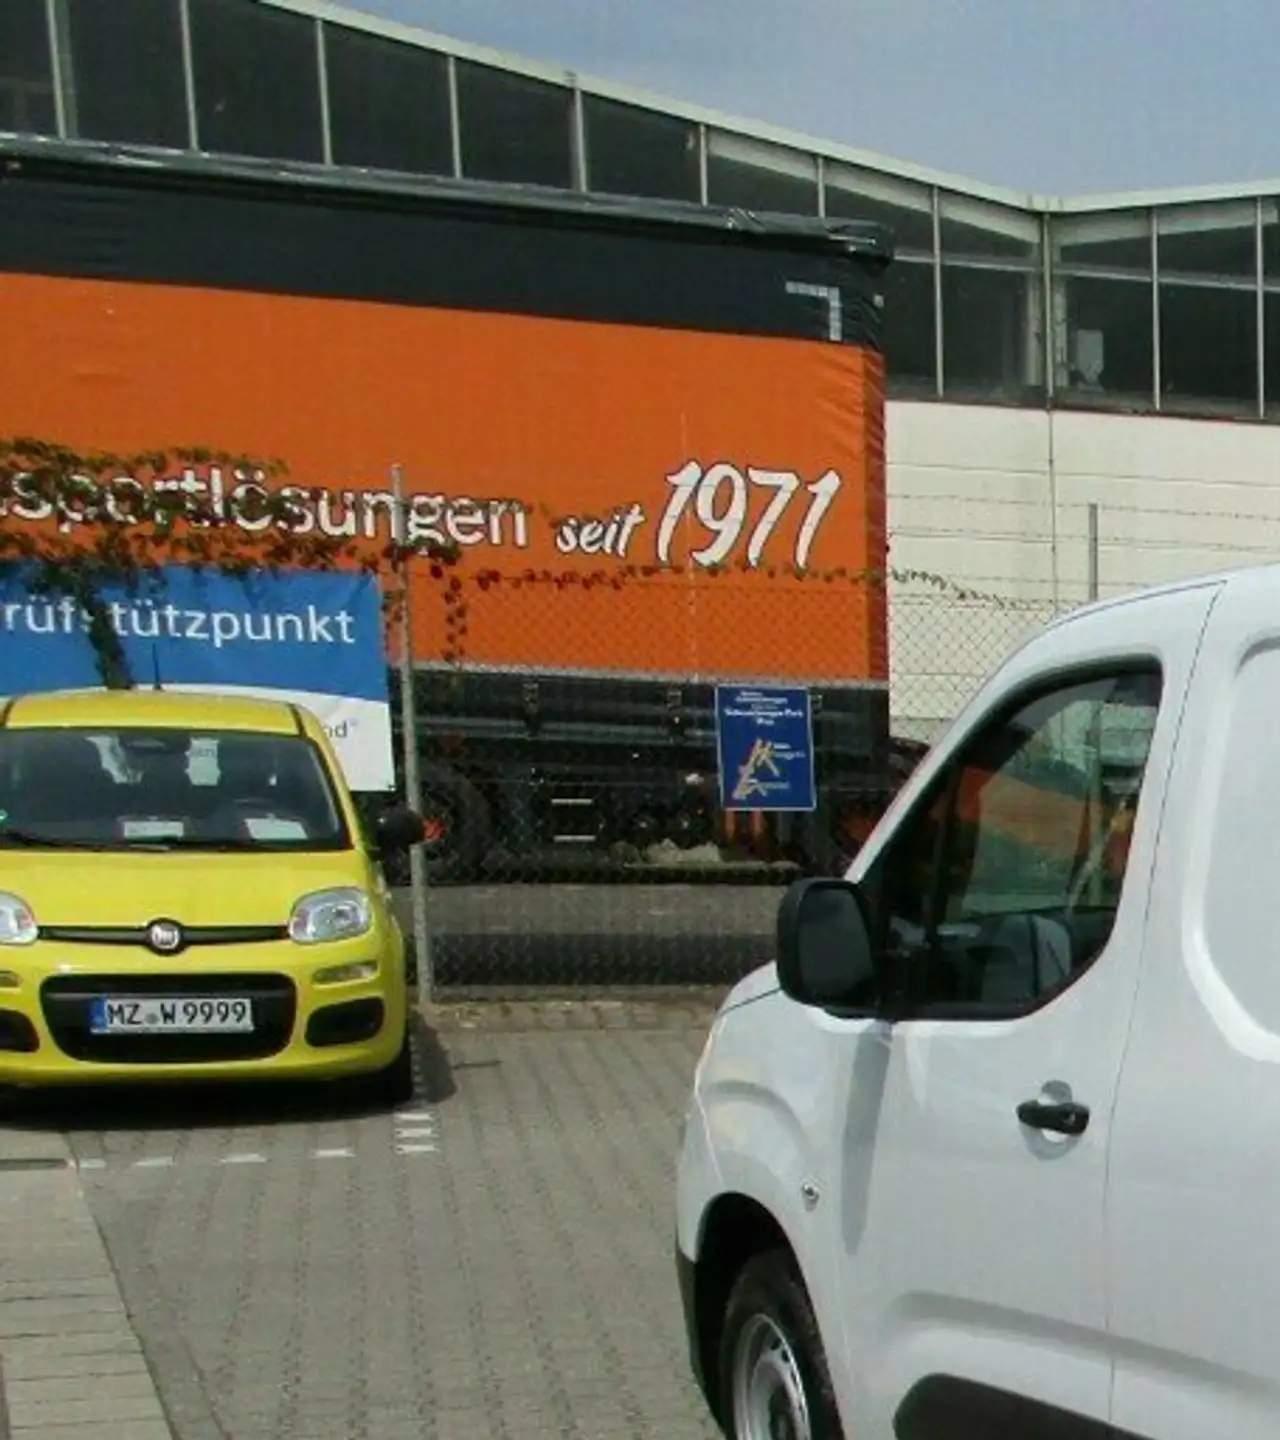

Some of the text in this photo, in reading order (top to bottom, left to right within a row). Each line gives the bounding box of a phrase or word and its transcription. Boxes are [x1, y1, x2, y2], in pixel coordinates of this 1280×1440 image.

[0, 460, 841, 562] sportlösungen seit 1971
[183, 1001, 246, 1025] 9999
